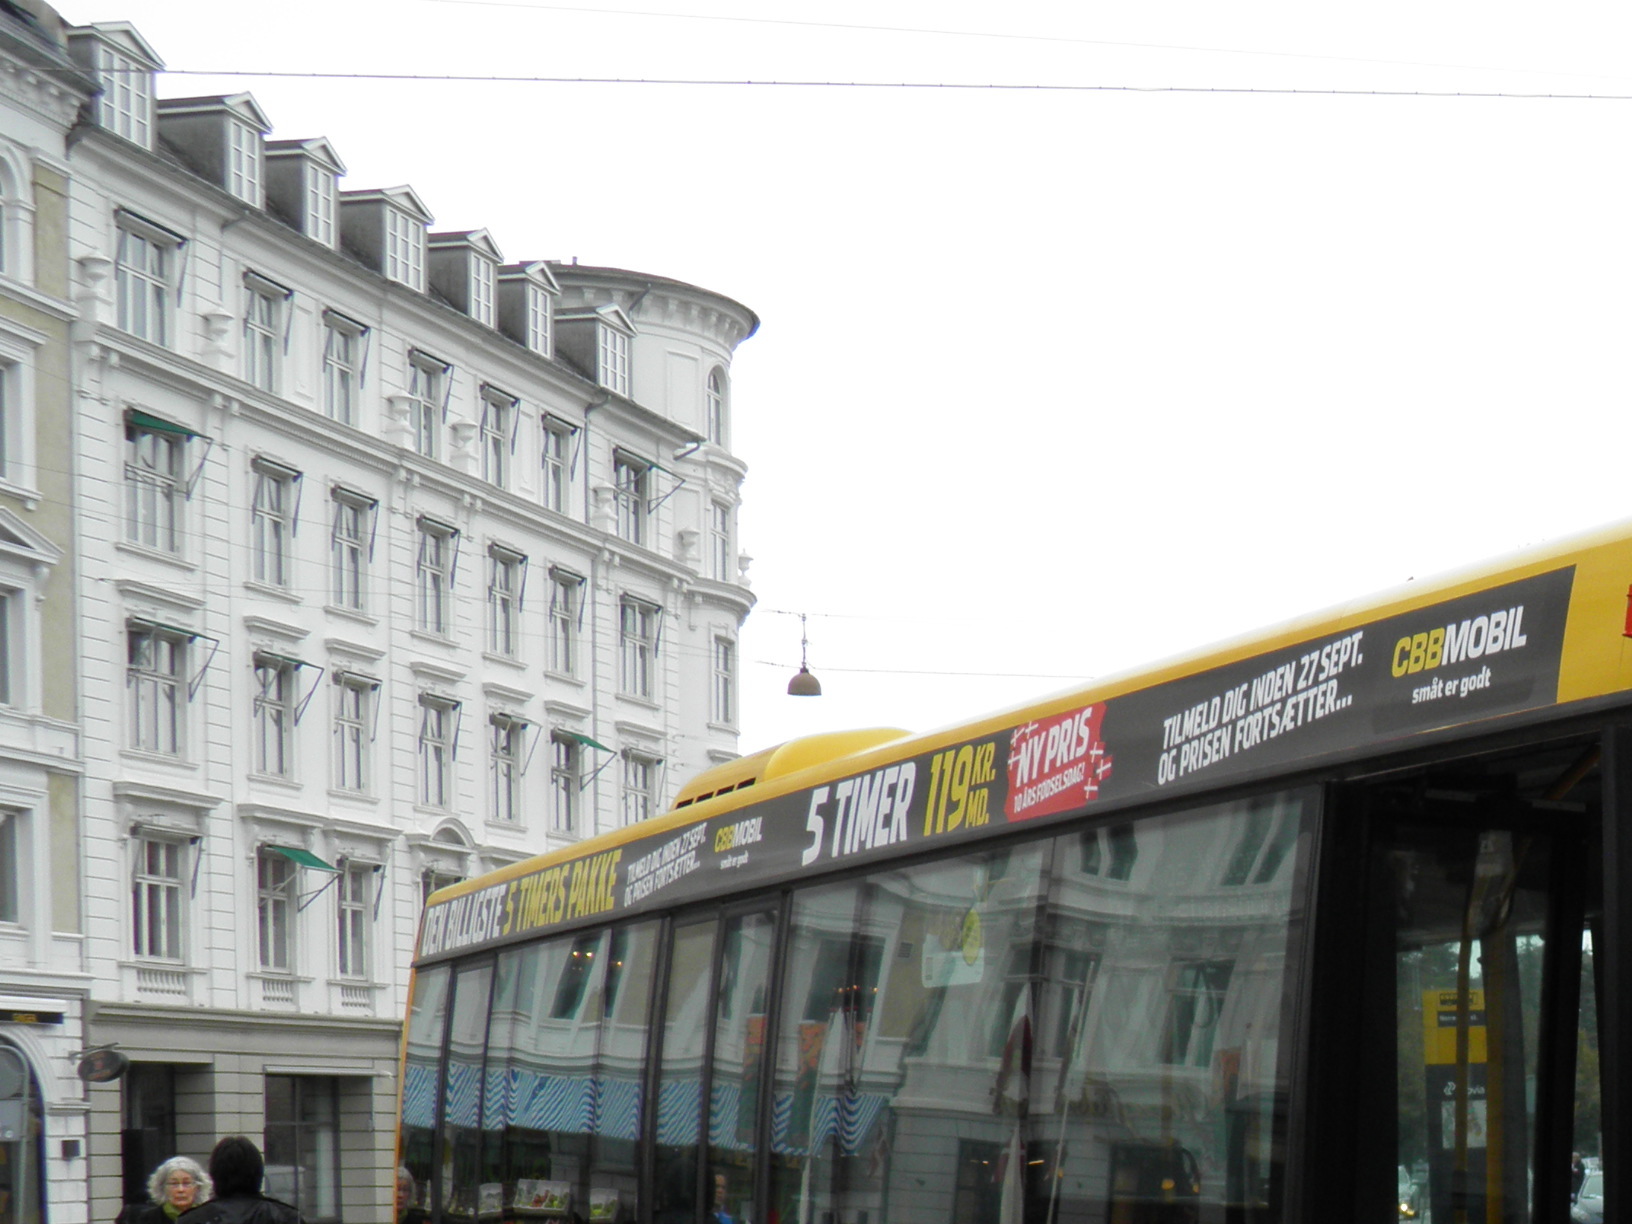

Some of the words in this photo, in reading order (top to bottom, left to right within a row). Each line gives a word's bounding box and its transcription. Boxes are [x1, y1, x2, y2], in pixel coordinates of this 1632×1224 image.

[1391, 605, 1528, 679] CBBMOBIL
[1411, 678, 1445, 704] småt
[1444, 679, 1459, 697] er
[1459, 666, 1492, 698] godt
[1157, 751, 1177, 785] OG
[1179, 724, 1233, 777] PRISEN
[1233, 678, 1353, 754] FORTSÆTTER...
[1163, 696, 1221, 750] TILMELD
[1222, 682, 1249, 725] DIG
[1250, 660, 1297, 712] INDEN
[1297, 650, 1321, 691] 27
[1318, 630, 1364, 681] SEPT.
[923, 744, 973, 837] 119
[971, 741, 996, 786] KR.
[1016, 731, 1047, 788] NY
[1043, 706, 1093, 774] PRIS
[714, 816, 763, 853] CBBMOBIL
[802, 786, 830, 867] 5
[831, 761, 917, 858] TIMER
[965, 787, 990, 829] MD.
[421, 902, 449, 957] DEN
[445, 883, 508, 951] BILLIGSTE
[502, 880, 518, 936] 5
[516, 864, 571, 932] TIMERS
[566, 848, 624, 920] PAKKE
